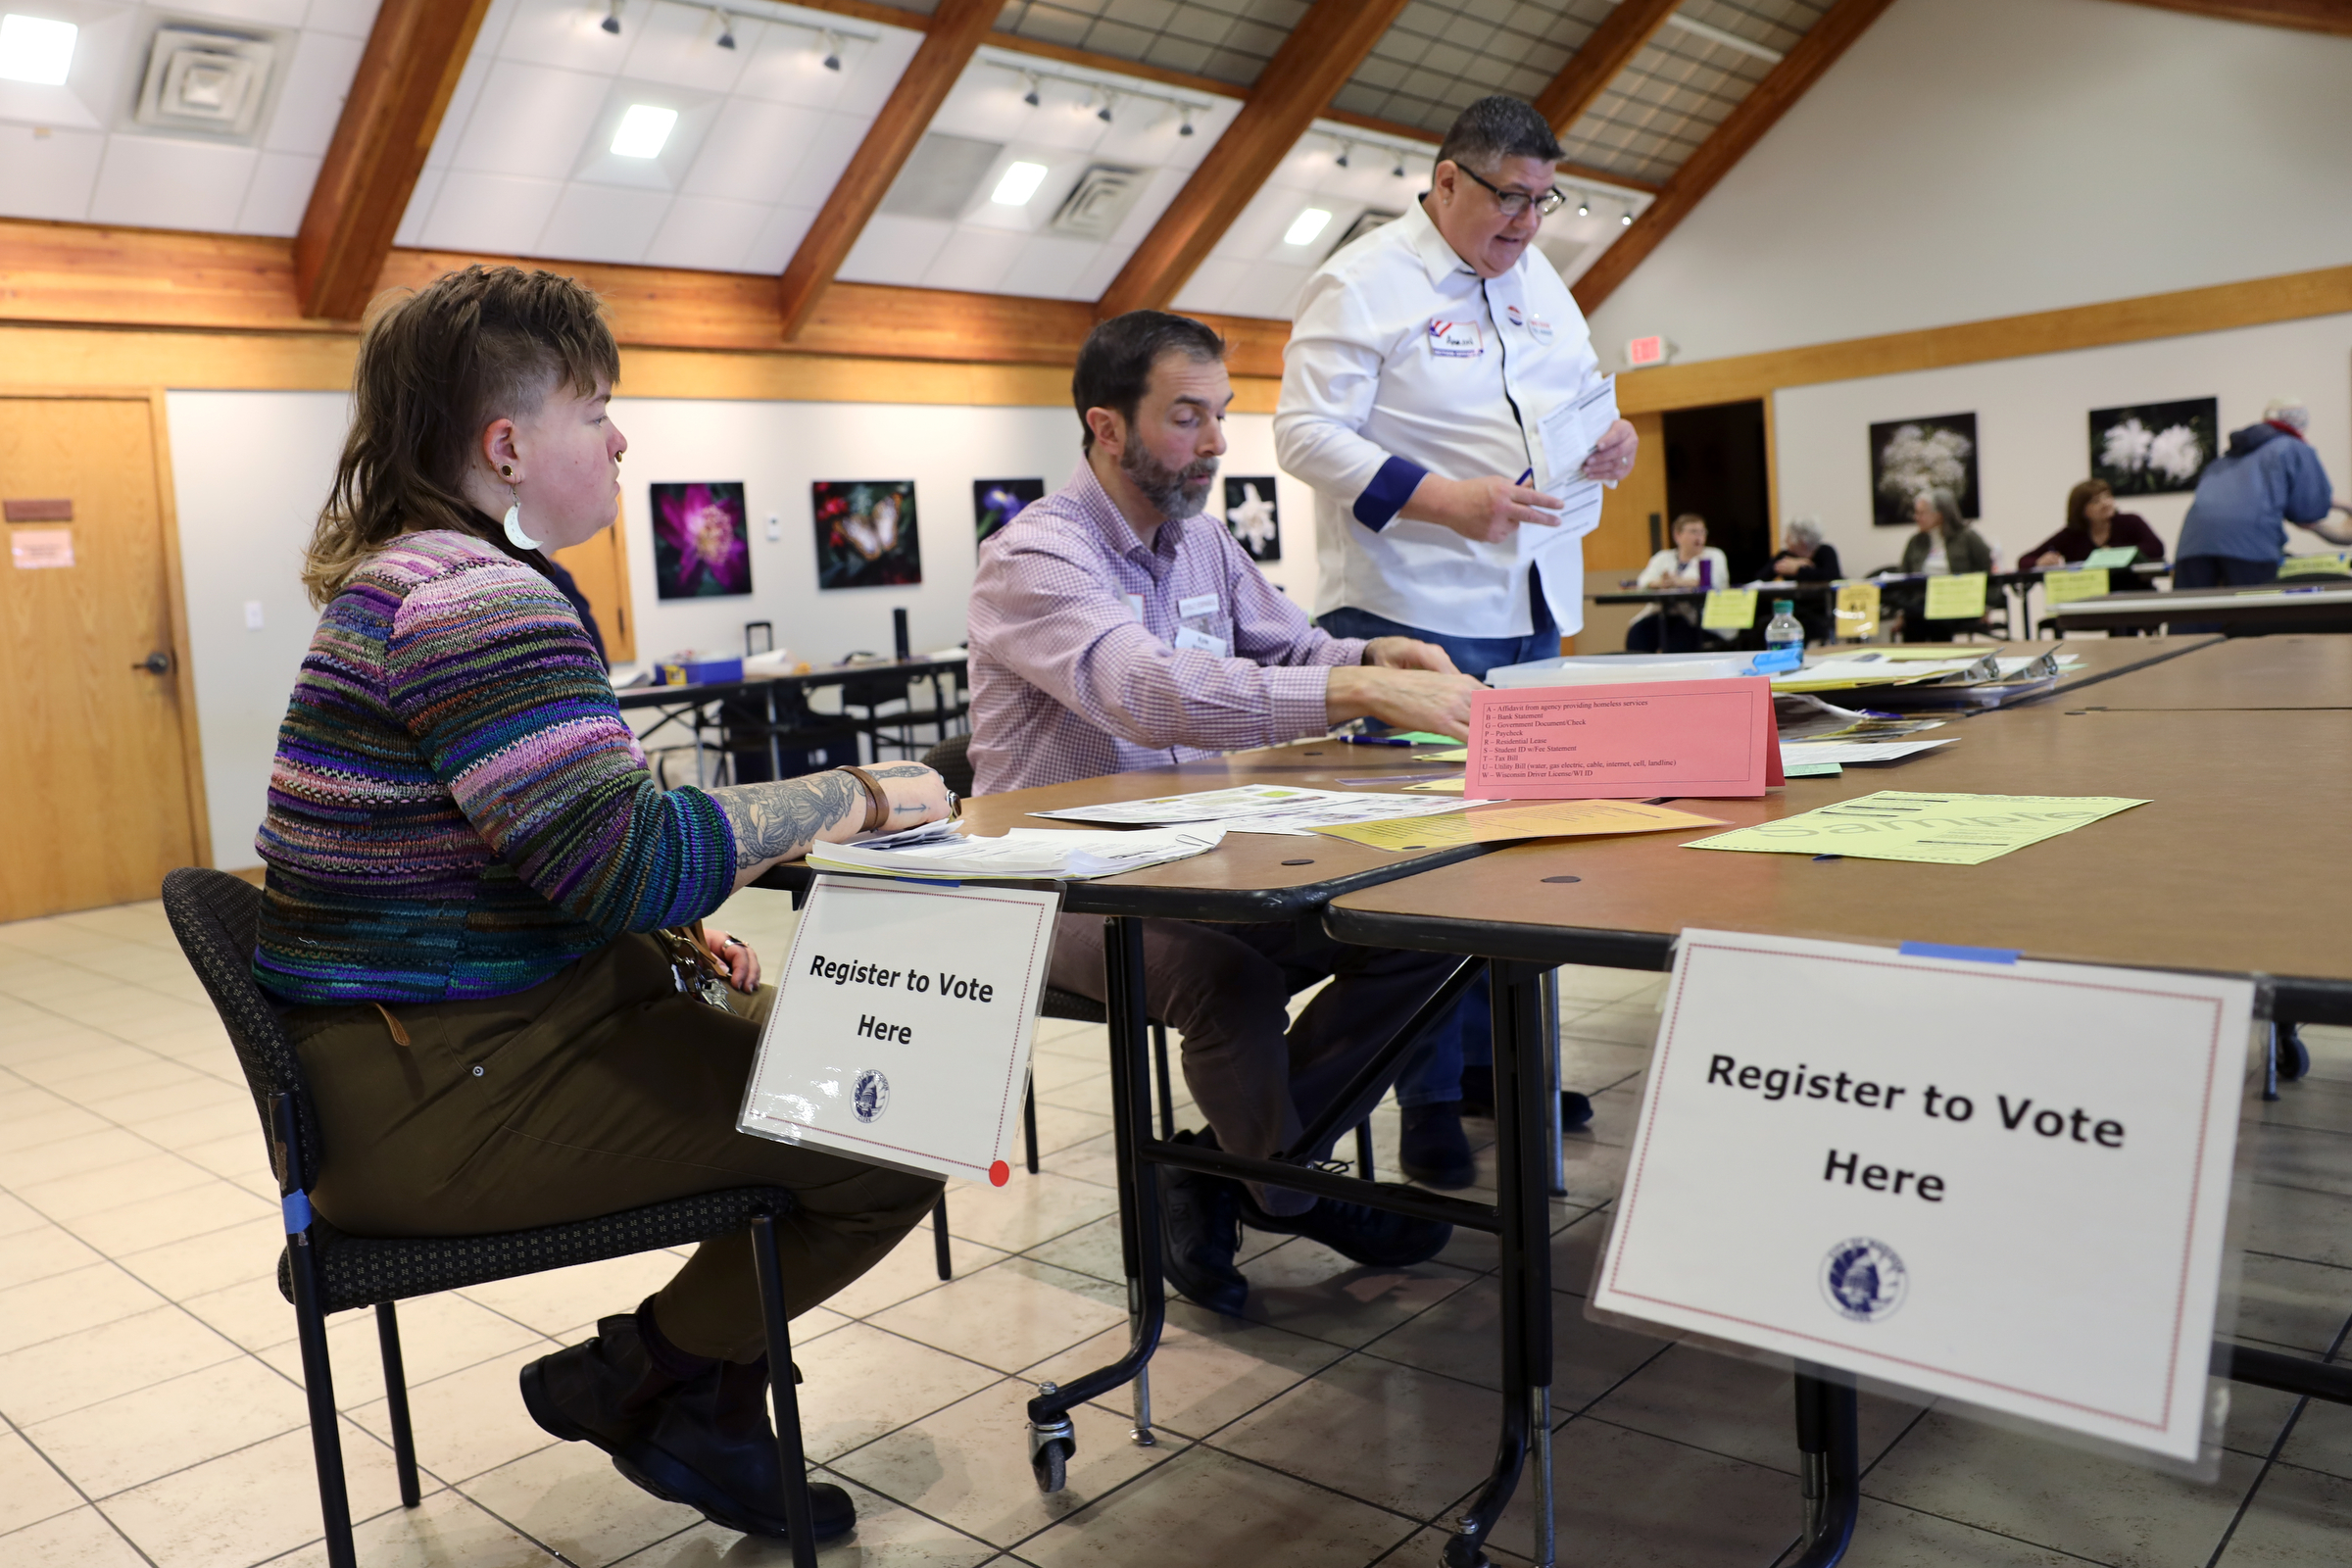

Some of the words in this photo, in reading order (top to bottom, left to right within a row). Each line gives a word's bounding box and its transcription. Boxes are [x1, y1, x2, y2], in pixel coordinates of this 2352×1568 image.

[1563, 702, 1592, 710] providing
[1753, 810, 2100, 838] Sample
[809, 955, 901, 987] Register
[906, 968, 930, 993] to
[940, 972, 994, 1004] Vote
[857, 1014, 912, 1045] Here
[1707, 1054, 1905, 1110] Register
[1924, 1085, 1974, 1122] to
[1997, 1095, 2125, 1149] Vote
[1824, 1150, 1944, 1202] Here
